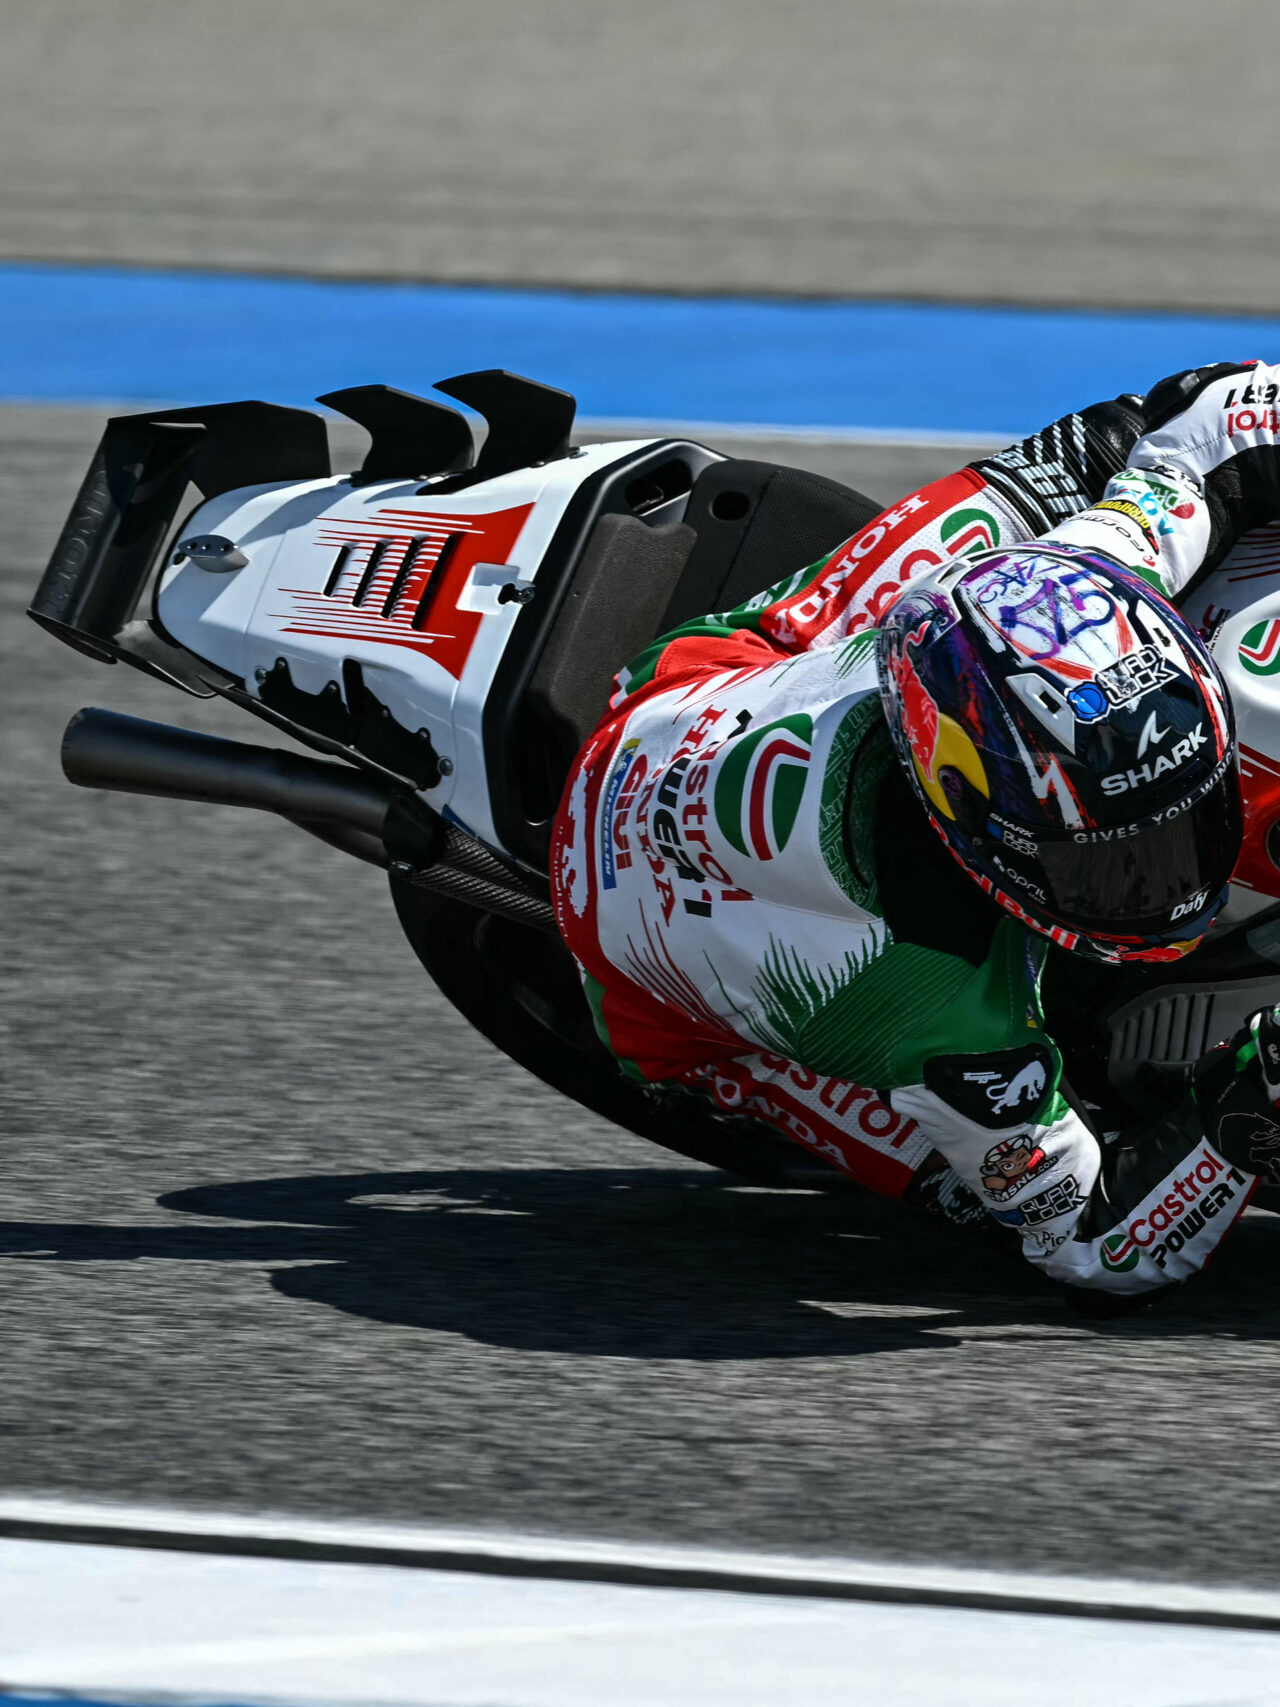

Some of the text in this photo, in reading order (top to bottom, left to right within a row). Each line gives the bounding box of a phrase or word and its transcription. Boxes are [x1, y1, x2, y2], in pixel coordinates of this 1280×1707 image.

[1101, 722, 1208, 797] SHARK
[604, 778, 618, 876] MICHELIN
[614, 754, 648, 870] GIVI
[989, 812, 1035, 837] SHARK
[1073, 823, 1139, 844] GIVES
[1152, 797, 1192, 826] YOU
[1170, 888, 1208, 921] Dafy
[758, 1052, 918, 1149] astrol
[1020, 1174, 1079, 1213] QUAD
[1026, 1188, 1096, 1226] LOCK
[1130, 1148, 1225, 1248] Castrol
[1150, 1167, 1247, 1268] POWER1
